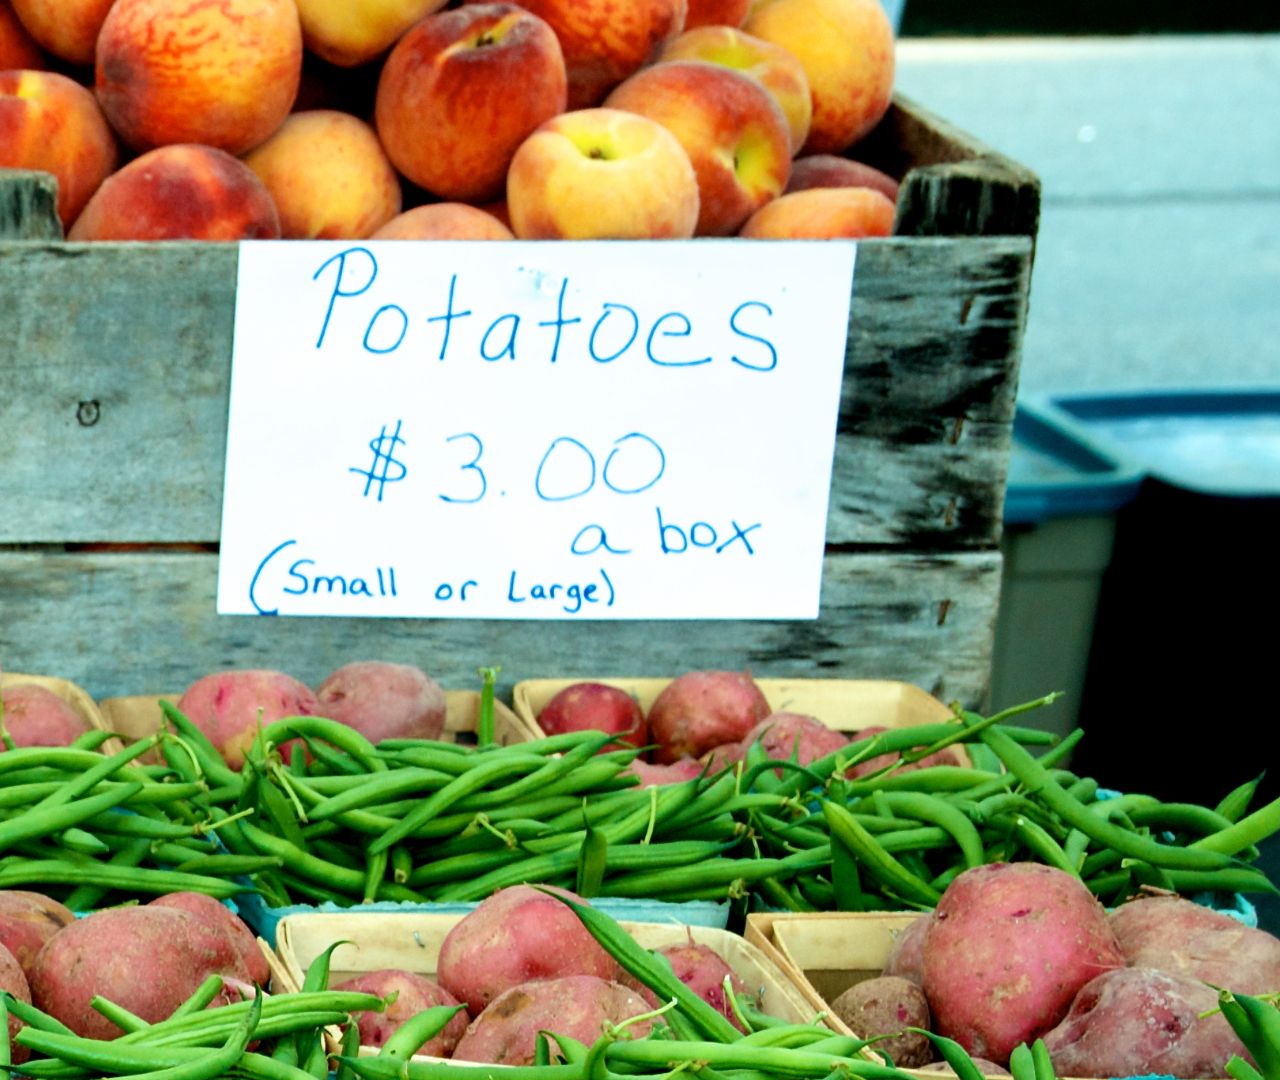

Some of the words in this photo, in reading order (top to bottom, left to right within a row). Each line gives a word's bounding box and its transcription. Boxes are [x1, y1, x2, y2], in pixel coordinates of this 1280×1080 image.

[312, 246, 778, 372] Potatoes
[570, 524, 632, 556] a
[656, 506, 762, 556] box
[249, 540, 401, 615] (Small
[434, 579, 478, 602] or
[507, 568, 615, 614] Large)
